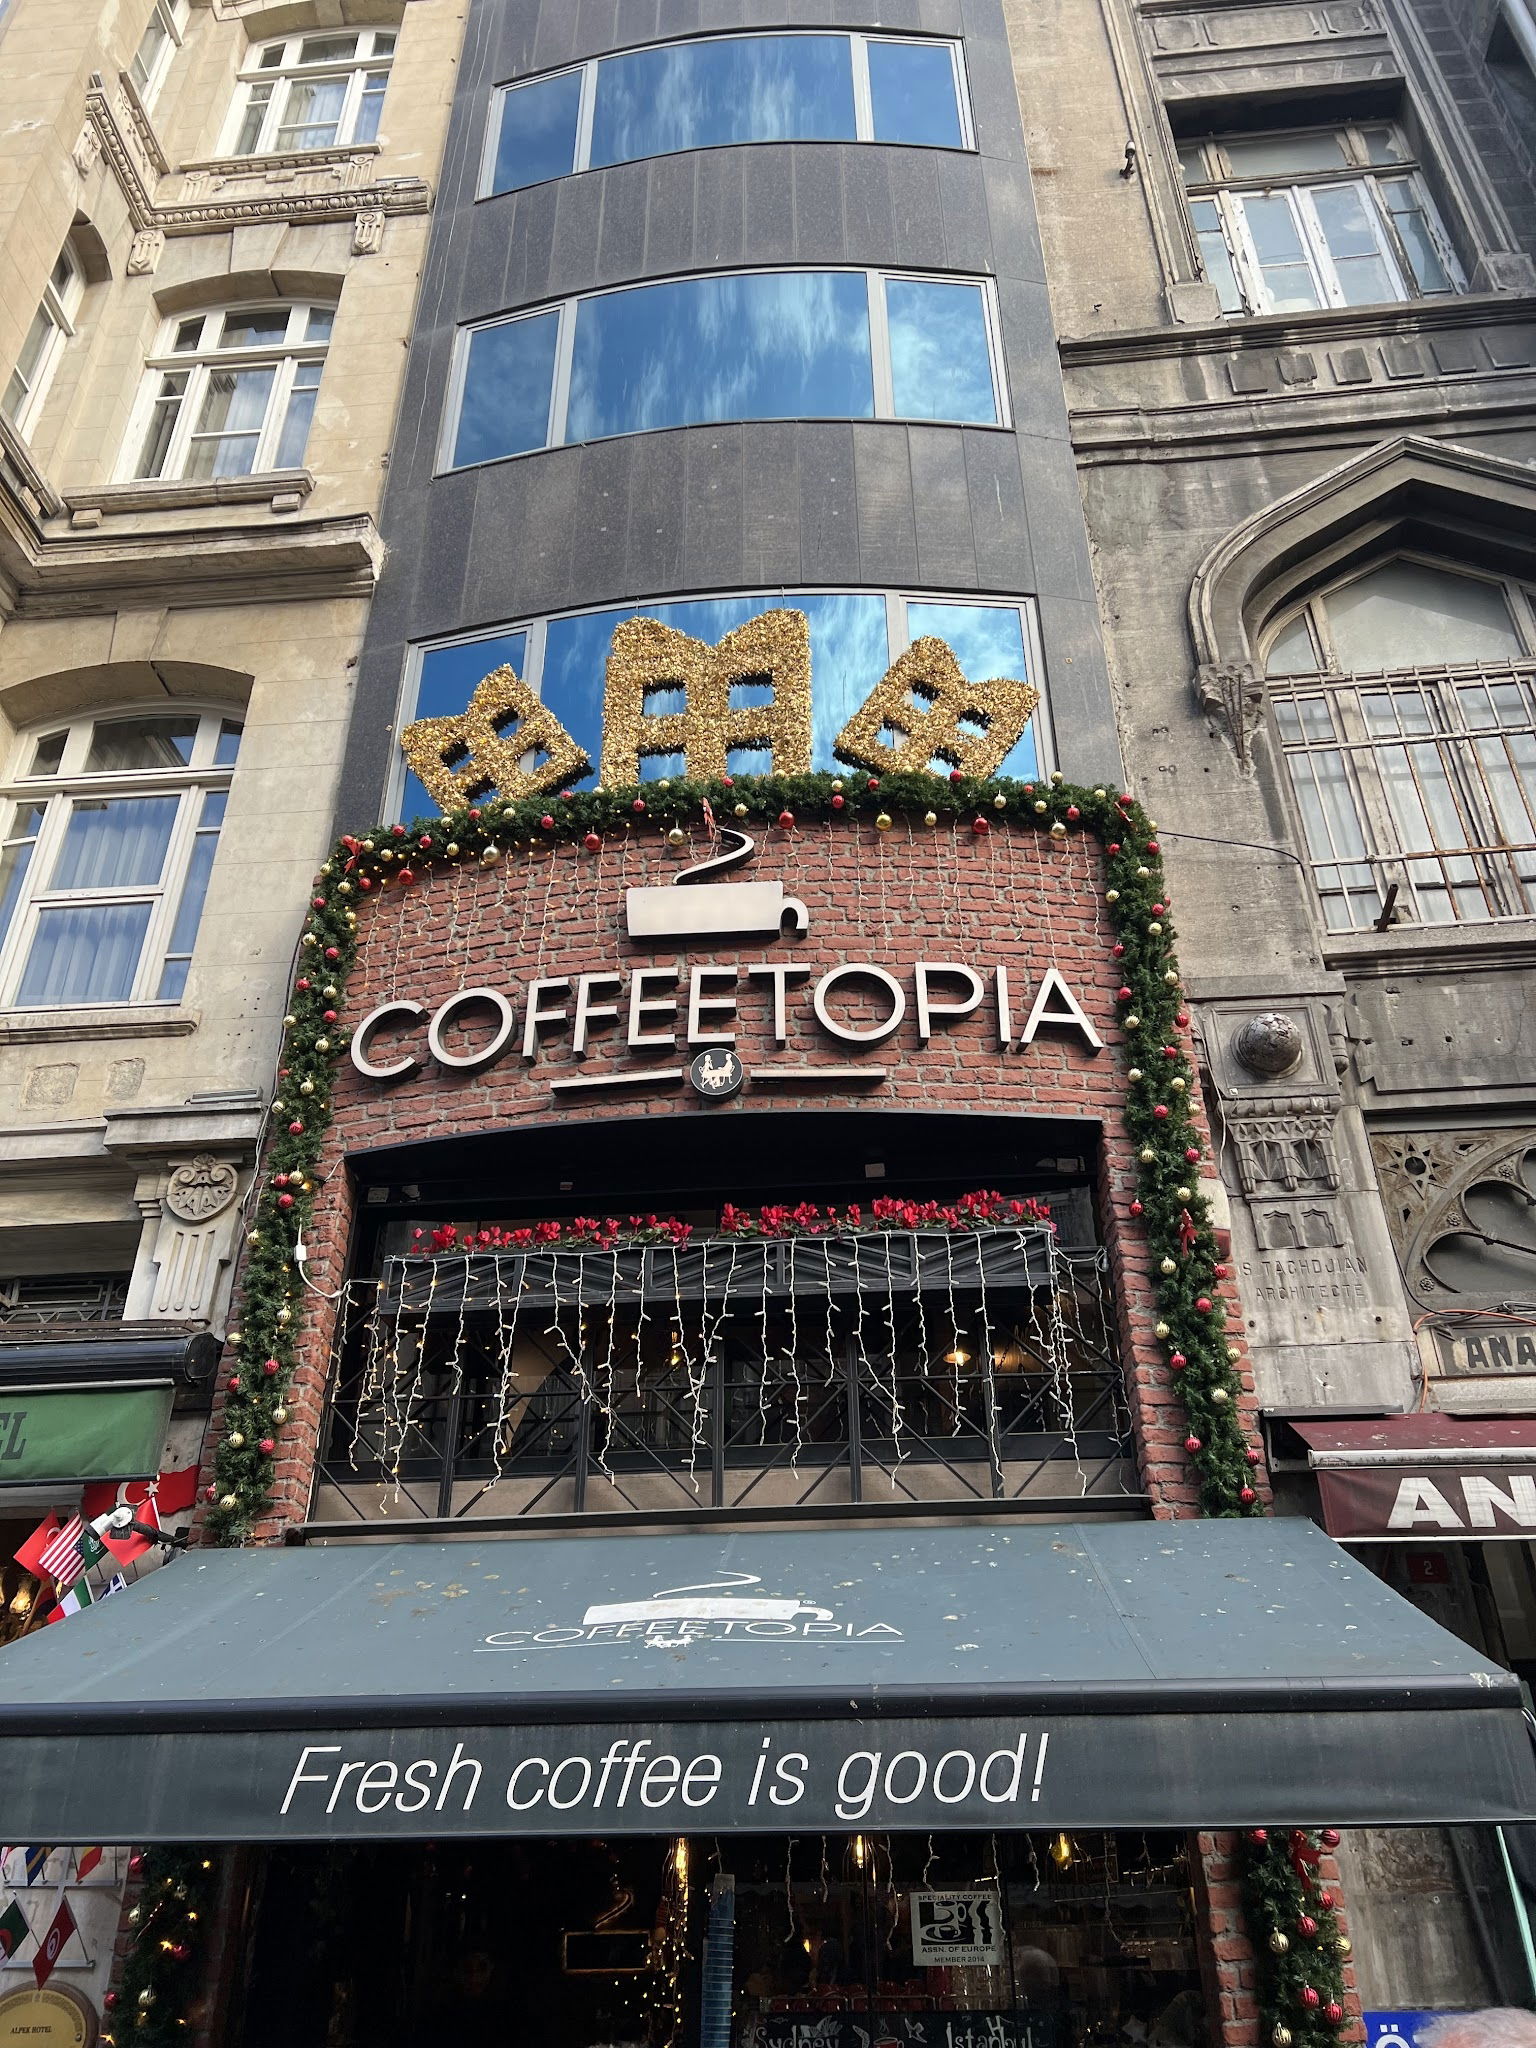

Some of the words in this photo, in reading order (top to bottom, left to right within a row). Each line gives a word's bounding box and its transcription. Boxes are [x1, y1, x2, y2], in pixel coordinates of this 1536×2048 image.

[350, 961, 1104, 1082] COFFEETOPIA
[1256, 1284, 1365, 1301] ARCHITECTE
[1423, 1560, 1434, 1576] 2
[484, 1620, 904, 1646] COFFEETOPIA
[280, 1742, 483, 1815] Fresh
[505, 1738, 723, 1812] coffee
[747, 1737, 809, 1807] is
[833, 1732, 1050, 1821] good!
[962, 1945, 996, 1953] EUROPE
[32, 2025, 52, 2033] HOTEL
